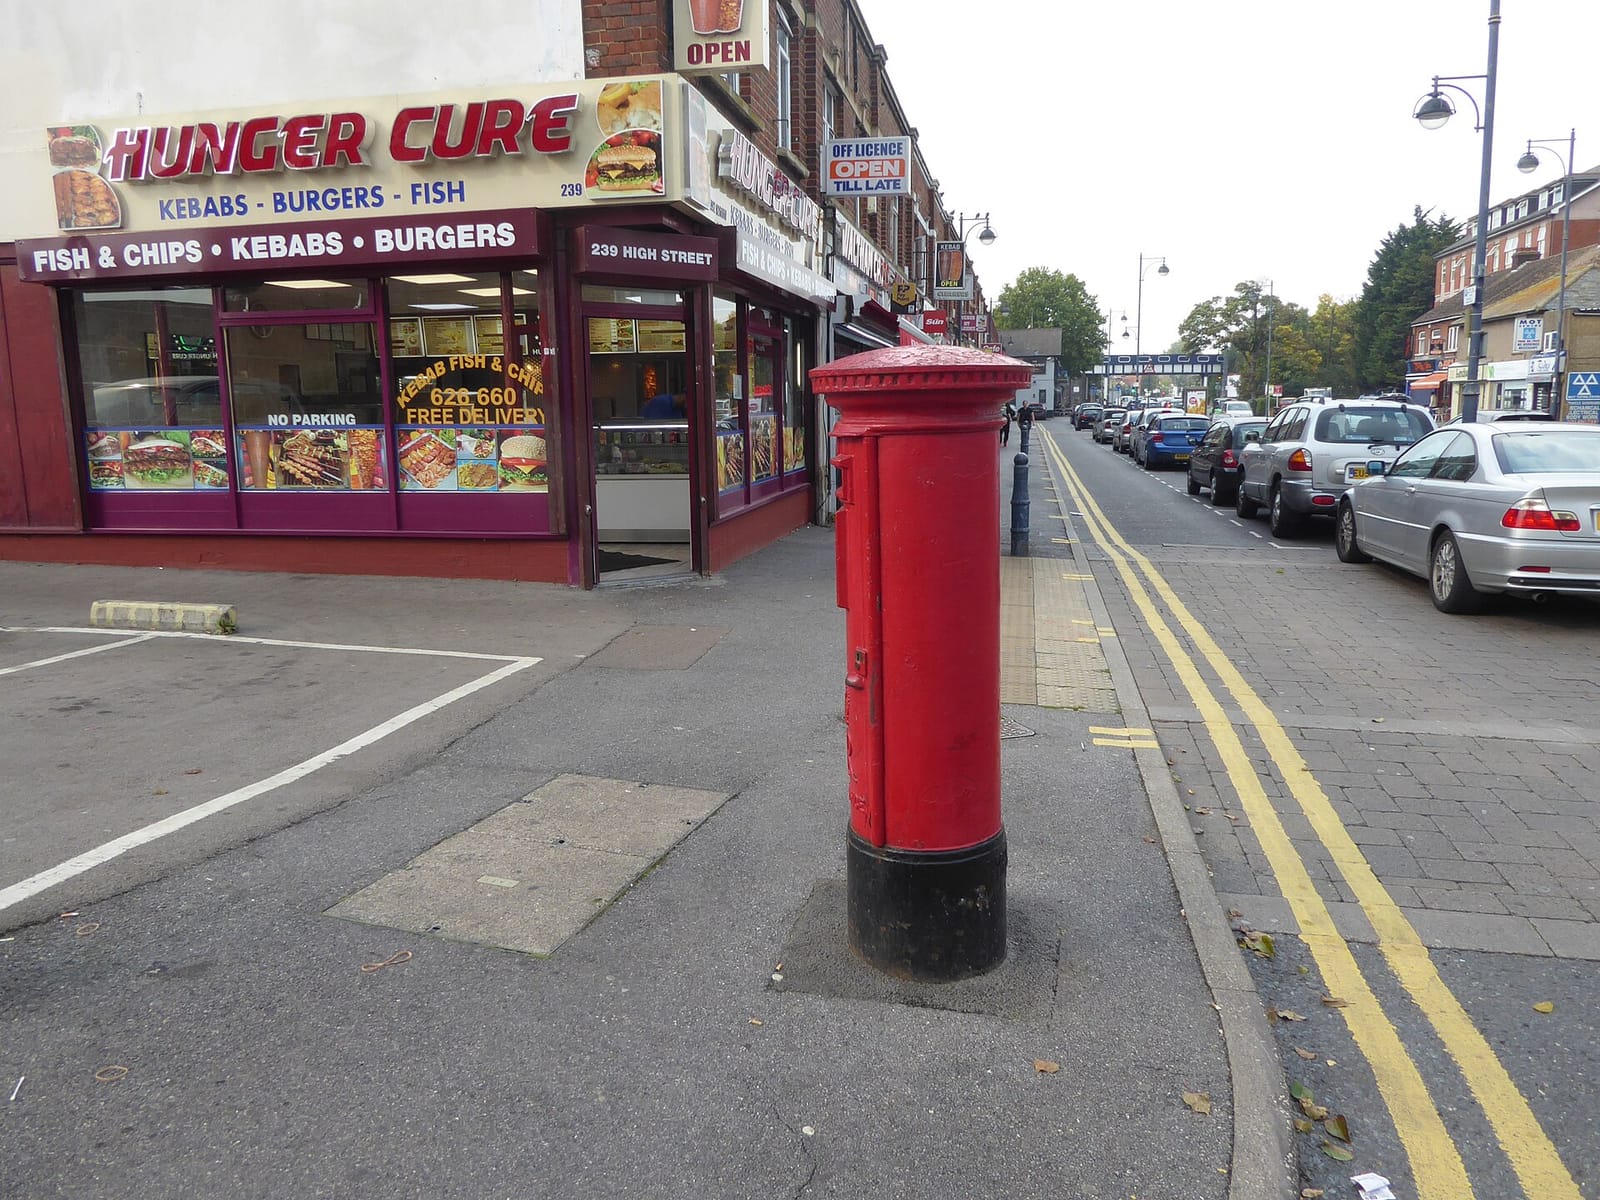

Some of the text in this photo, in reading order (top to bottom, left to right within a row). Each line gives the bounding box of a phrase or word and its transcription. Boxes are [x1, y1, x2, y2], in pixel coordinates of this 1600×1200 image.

[687, 40, 751, 65] OPEN
[103, 92, 580, 179] HUNGER CURE
[832, 142, 903, 158] OFF LICENCE
[835, 159, 901, 177] OPEN
[561, 183, 582, 197] 239
[730, 130, 820, 241] HUNGER CURE
[834, 179, 901, 191] TILL LATE
[159, 194, 249, 220] KEBABS
[273, 185, 384, 213] BURGERS
[411, 180, 465, 205] FISH
[33, 222, 516, 273] FISH & CHIPS KEBABS BURGERS
[591, 243, 713, 266] 239 HIGH STREET
[741, 238, 759, 269] FISH
[767, 254, 787, 280] CHIPS
[396, 361, 446, 408] KEBAB
[449, 355, 486, 371] FISH
[491, 357, 502, 372] &
[430, 387, 517, 406] 626 660
[266, 413, 356, 426] NO PARKING
[407, 408, 456, 425] FREE
